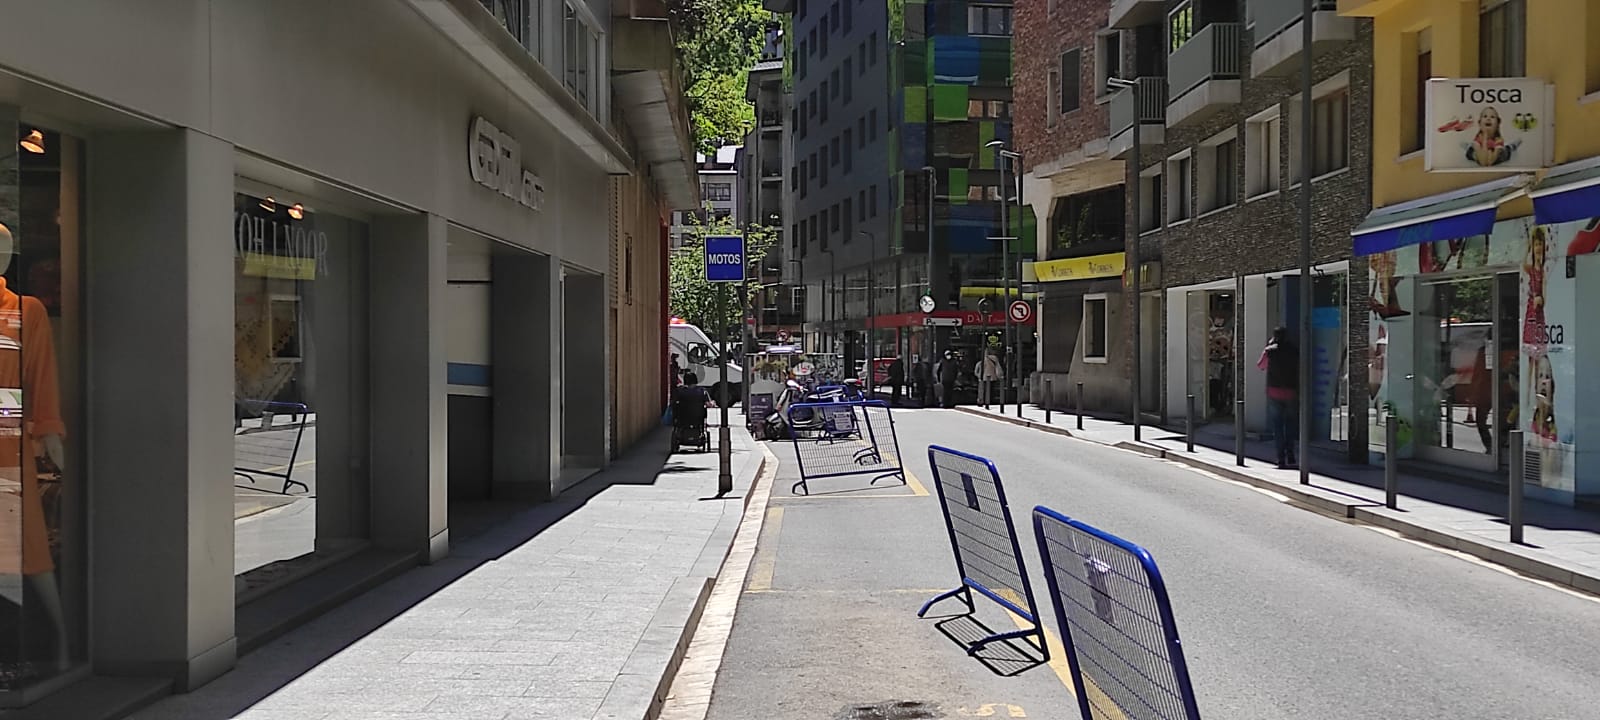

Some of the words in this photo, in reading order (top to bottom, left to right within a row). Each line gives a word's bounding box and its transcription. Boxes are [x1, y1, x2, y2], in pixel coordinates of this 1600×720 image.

[1455, 84, 1522, 104] Tosca
[285, 224, 329, 277] NOOR
[708, 254, 741, 265] MOTOS
